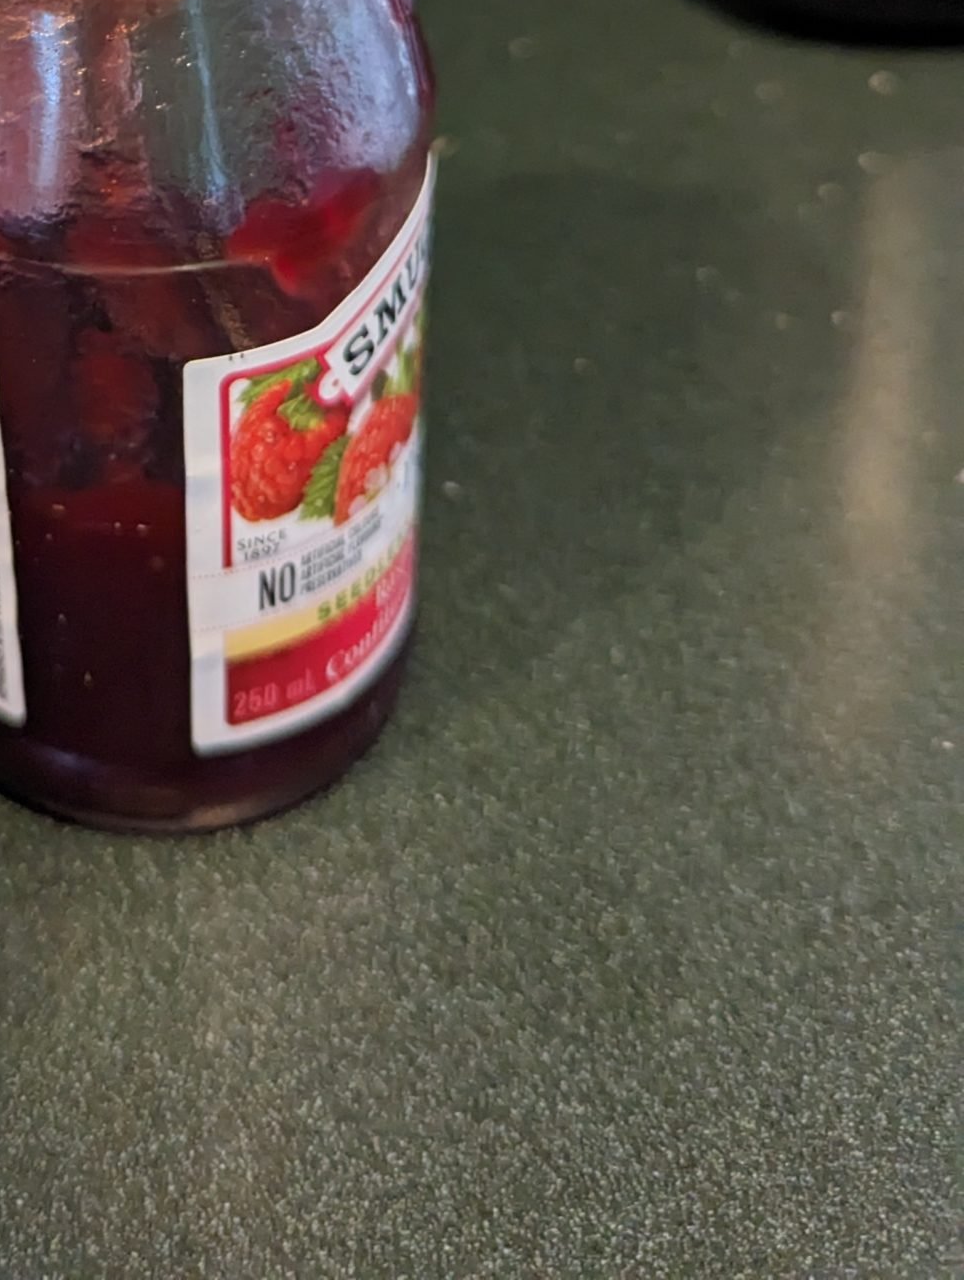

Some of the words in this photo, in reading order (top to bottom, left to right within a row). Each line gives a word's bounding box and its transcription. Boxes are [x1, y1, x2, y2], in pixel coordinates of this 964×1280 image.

[237, 528, 286, 552] SINCE
[244, 541, 280, 563] 1897
[259, 561, 296, 611] NO
[234, 682, 279, 717] 250
